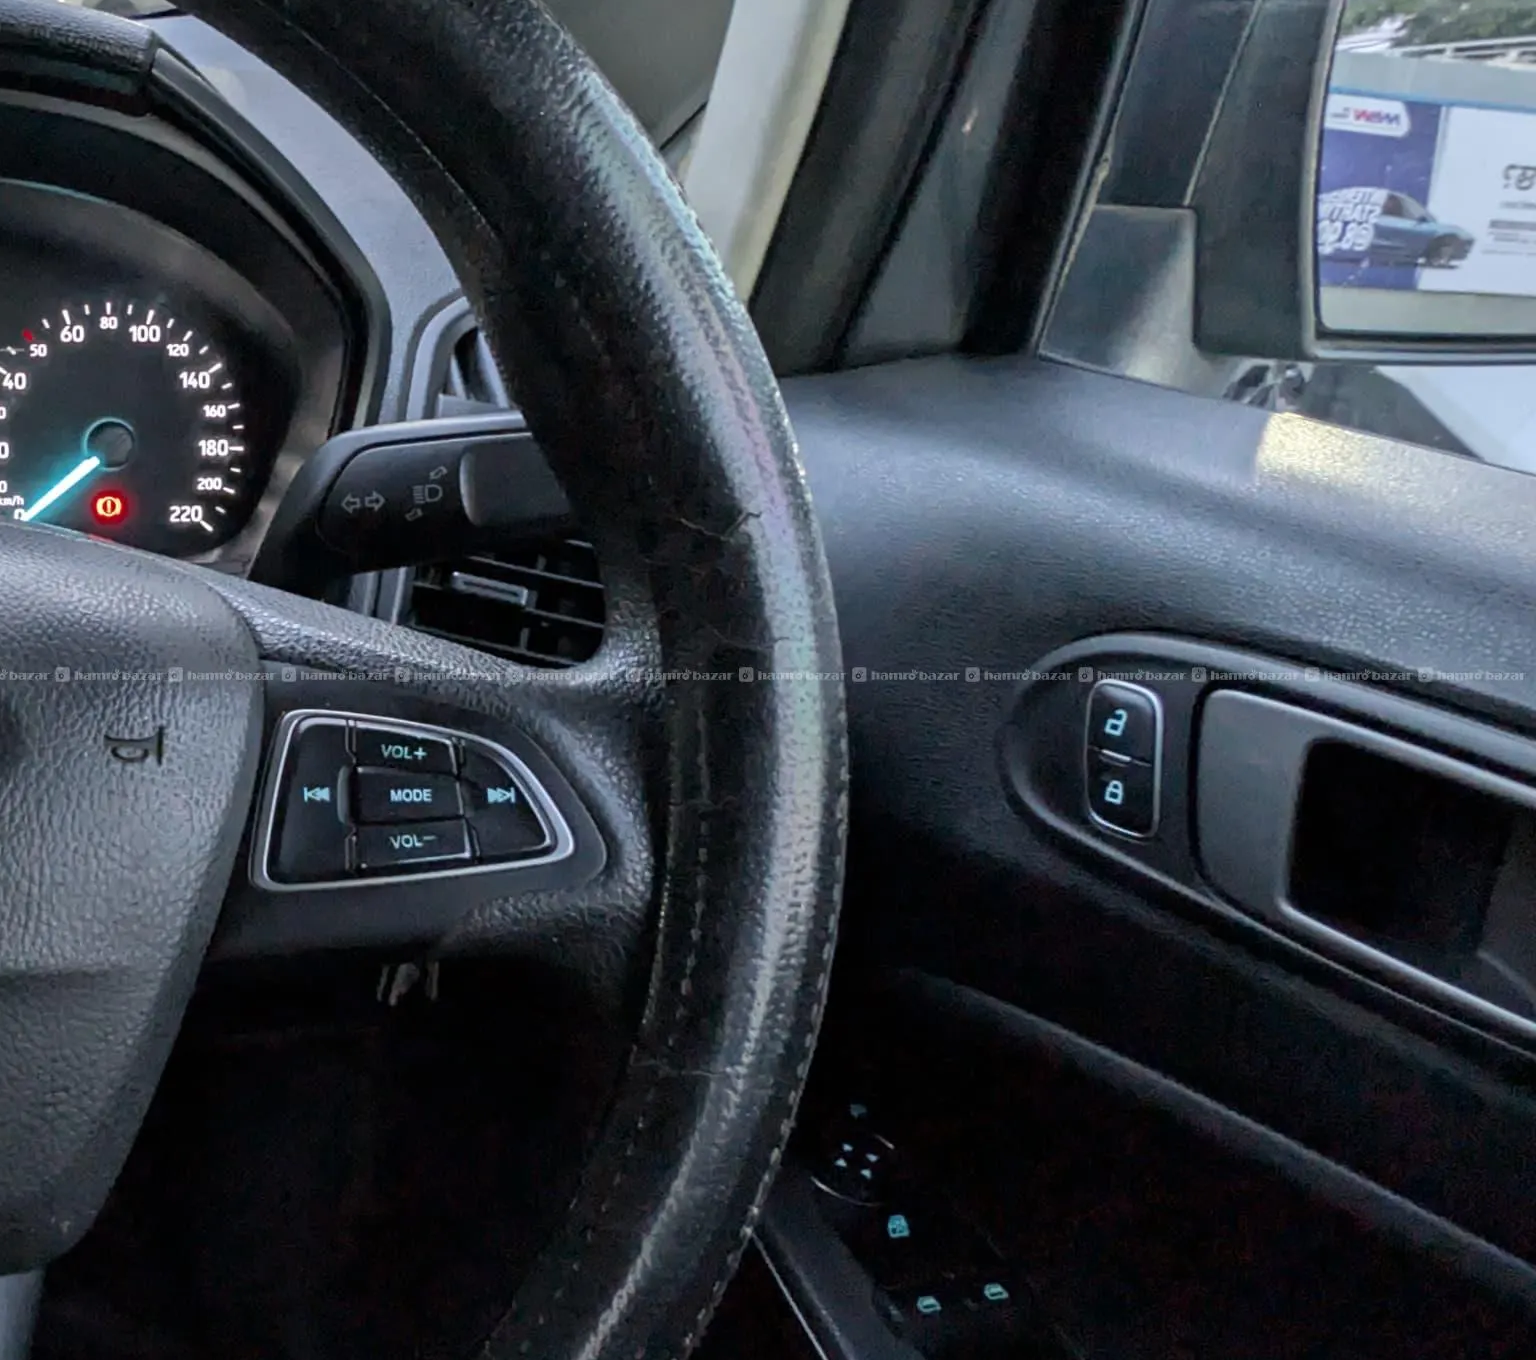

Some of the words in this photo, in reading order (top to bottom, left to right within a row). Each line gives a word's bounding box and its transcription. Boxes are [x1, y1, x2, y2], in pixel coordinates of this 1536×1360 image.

[99, 316, 118, 329] 80
[60, 325, 85, 342] 60
[128, 325, 161, 342] 100
[29, 343, 47, 357] 50
[166, 343, 190, 357] 120
[2, 372, 27, 389] 40
[179, 371, 210, 389] 140
[203, 404, 227, 418] 160
[198, 440, 229, 457] 180
[196, 477, 222, 491] 200
[169, 505, 202, 523] 220
[380, 743, 428, 761] VOL+
[390, 788, 433, 803] MODE
